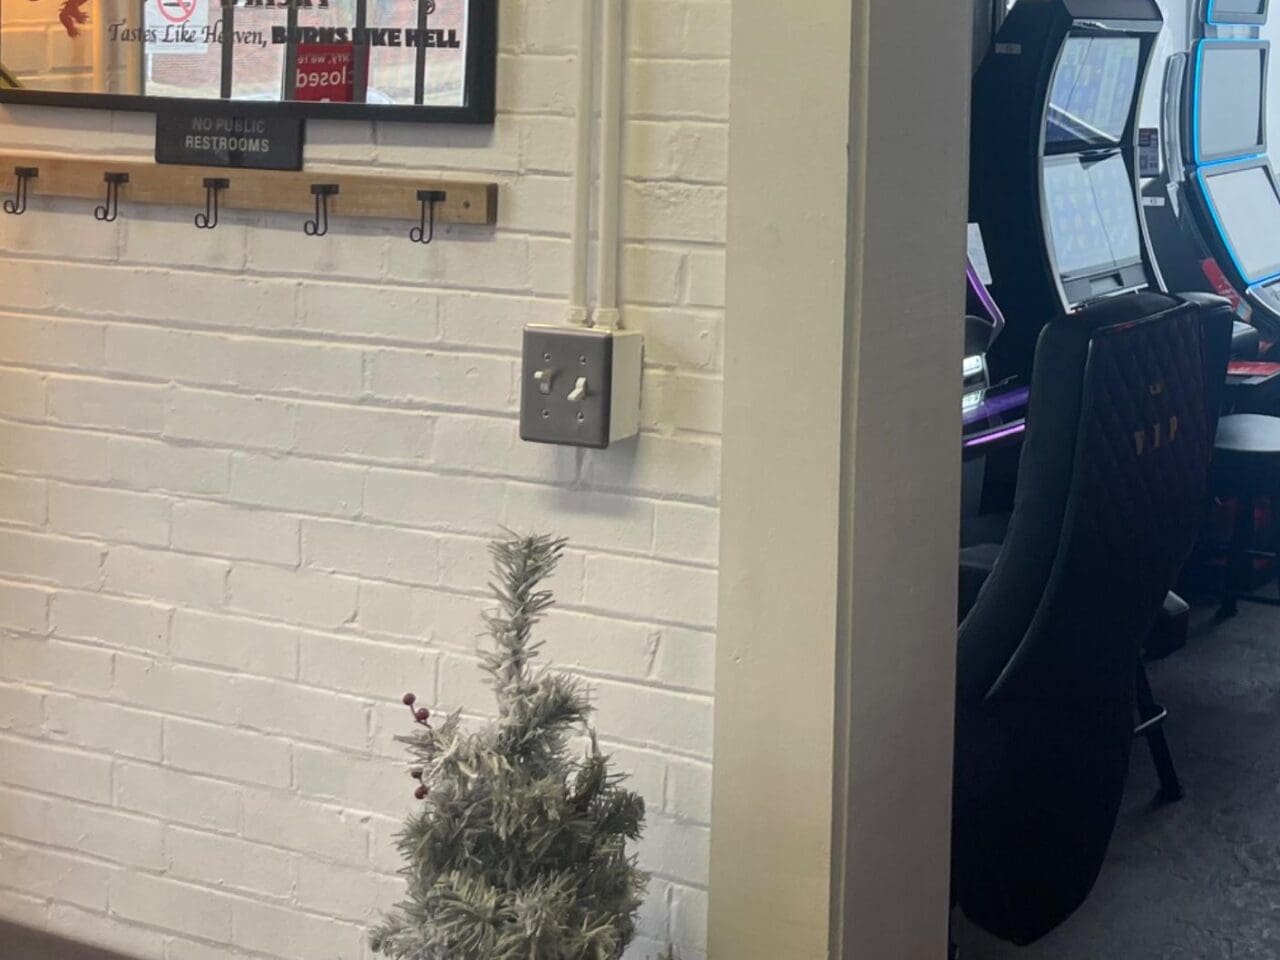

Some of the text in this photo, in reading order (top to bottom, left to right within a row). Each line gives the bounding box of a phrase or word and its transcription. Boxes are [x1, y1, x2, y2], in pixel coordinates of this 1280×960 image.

[161, 18, 197, 44] Like
[201, 17, 268, 49] Heven,
[192, 117, 265, 134] NO PUBLIC
[185, 135, 270, 153] RESTROOMS
